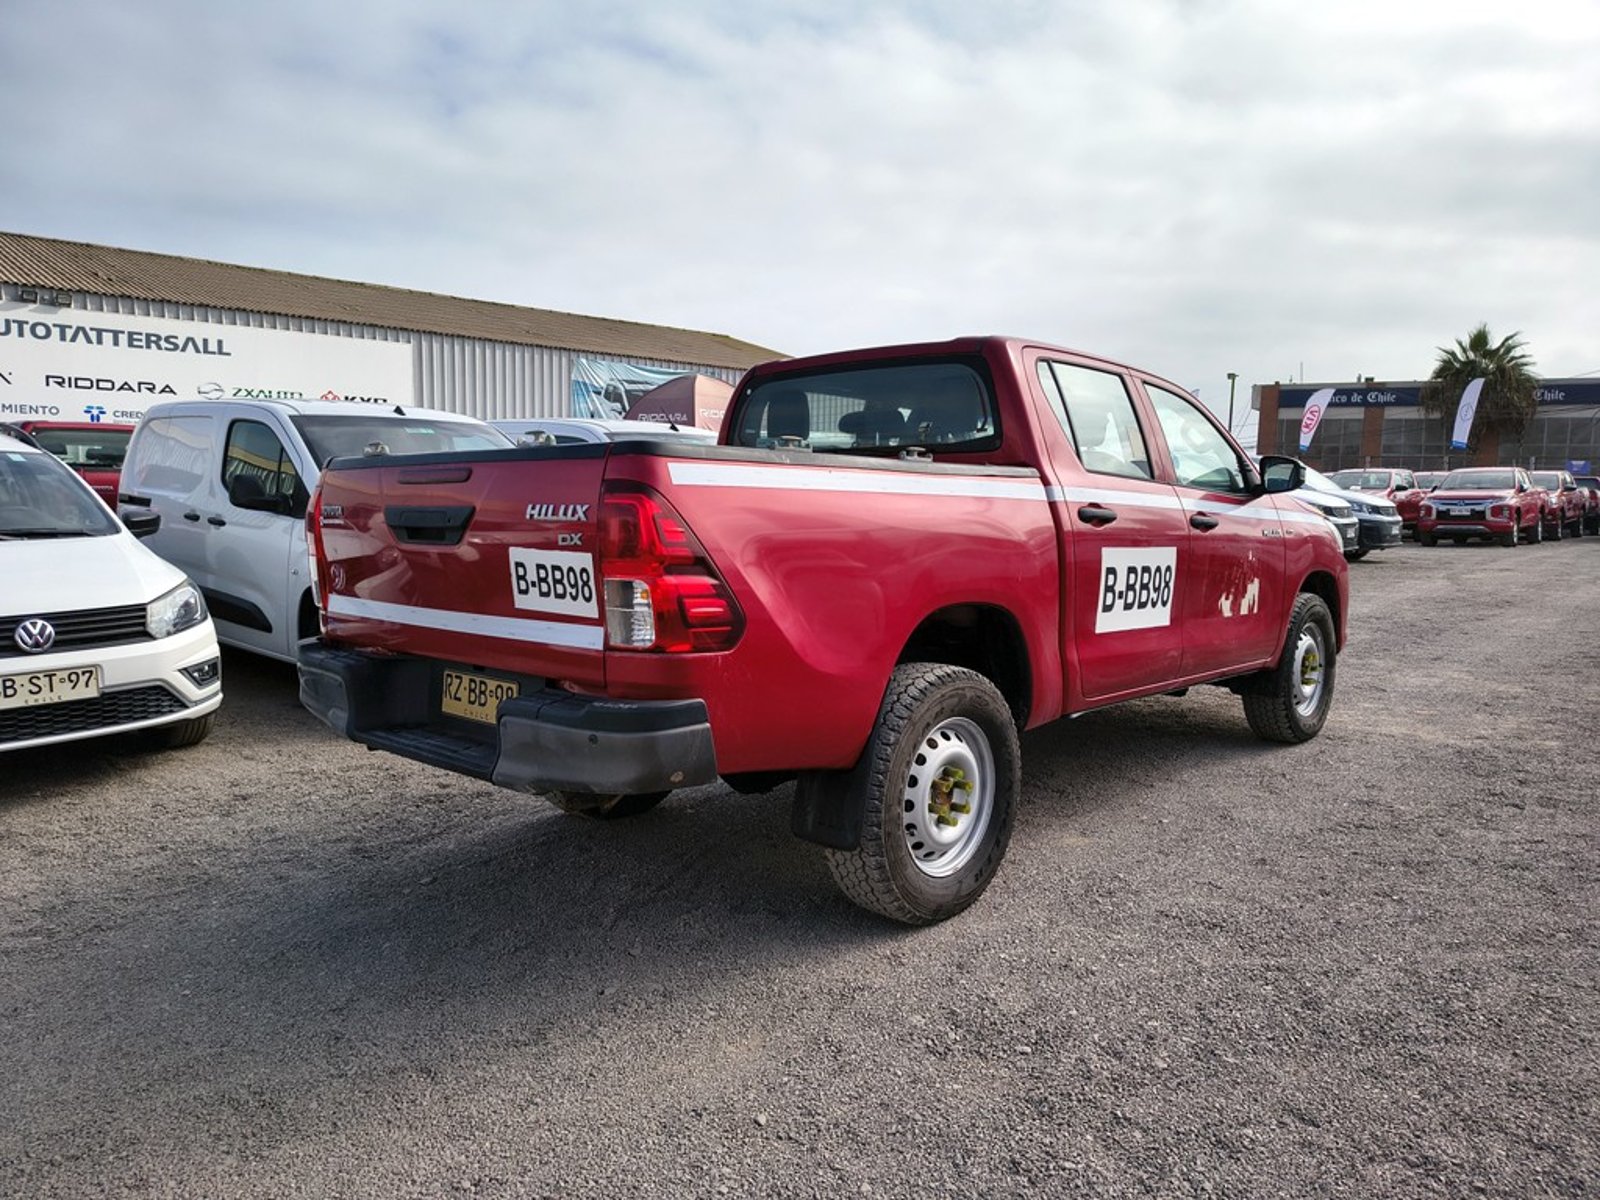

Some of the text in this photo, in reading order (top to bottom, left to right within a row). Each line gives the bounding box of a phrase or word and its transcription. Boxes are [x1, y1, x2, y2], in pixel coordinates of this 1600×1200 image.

[45, 375, 177, 395] RIDDARA
[1351, 393, 1362, 403] de
[1367, 391, 1396, 403] Chile
[1533, 389, 1566, 401] Chile
[1, 403, 60, 416] MIENTO
[1302, 408, 1319, 430] KIA
[525, 503, 589, 521] HILUX
[558, 533, 582, 545] DX
[514, 561, 593, 603] B-BB98
[1101, 565, 1172, 613] B-BB98
